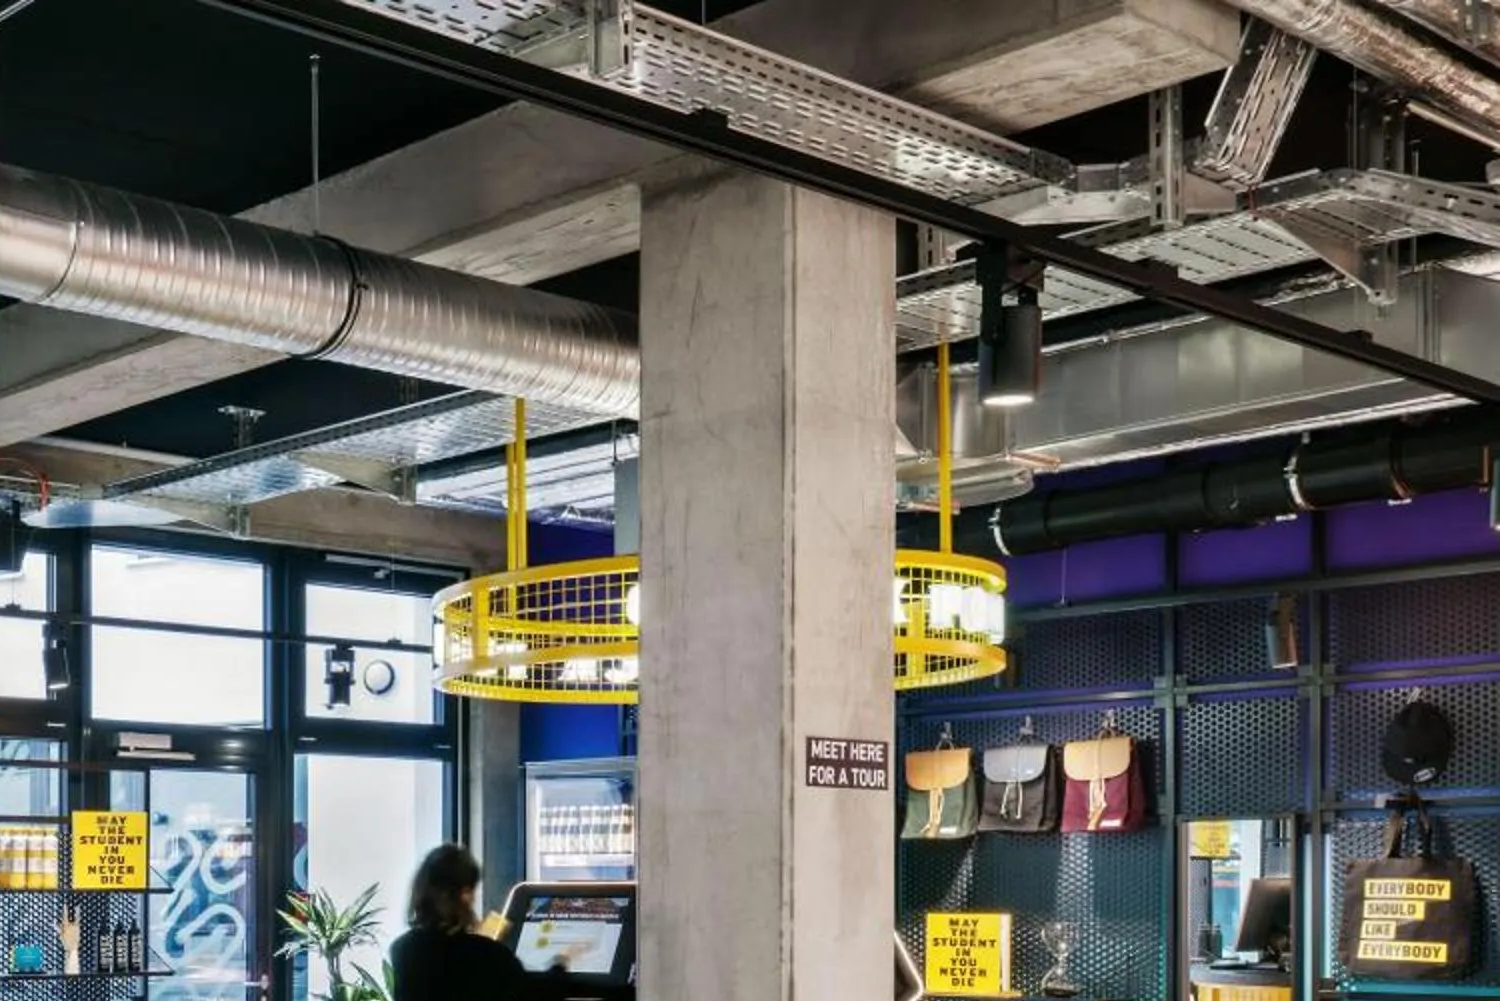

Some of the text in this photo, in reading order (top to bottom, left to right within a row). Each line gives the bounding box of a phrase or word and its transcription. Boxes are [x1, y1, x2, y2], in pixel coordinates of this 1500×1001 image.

[811, 740, 884, 762] MEET HERE
[809, 765, 886, 787] FOR A TOUR
[97, 816, 126, 824] MAY
[99, 826, 125, 834] THE
[80, 836, 142, 844] STUDENT
[105, 846, 119, 854] IN
[100, 856, 125, 864] YOU
[88, 866, 134, 874] NEVER
[101, 876, 123, 884] DIE
[1369, 882, 1445, 895] EVERYBODY
[1368, 903, 1416, 916] SHOULD
[949, 918, 979, 927] MAY
[950, 928, 976, 936] THE
[1365, 924, 1391, 936] LIKE
[932, 938, 996, 947] STUDENT
[955, 948, 970, 956] IN
[1363, 944, 1442, 958] EVERYBODY
[950, 958, 976, 966] YOU
[940, 968, 987, 977] NEVER
[951, 978, 975, 986] DIE
